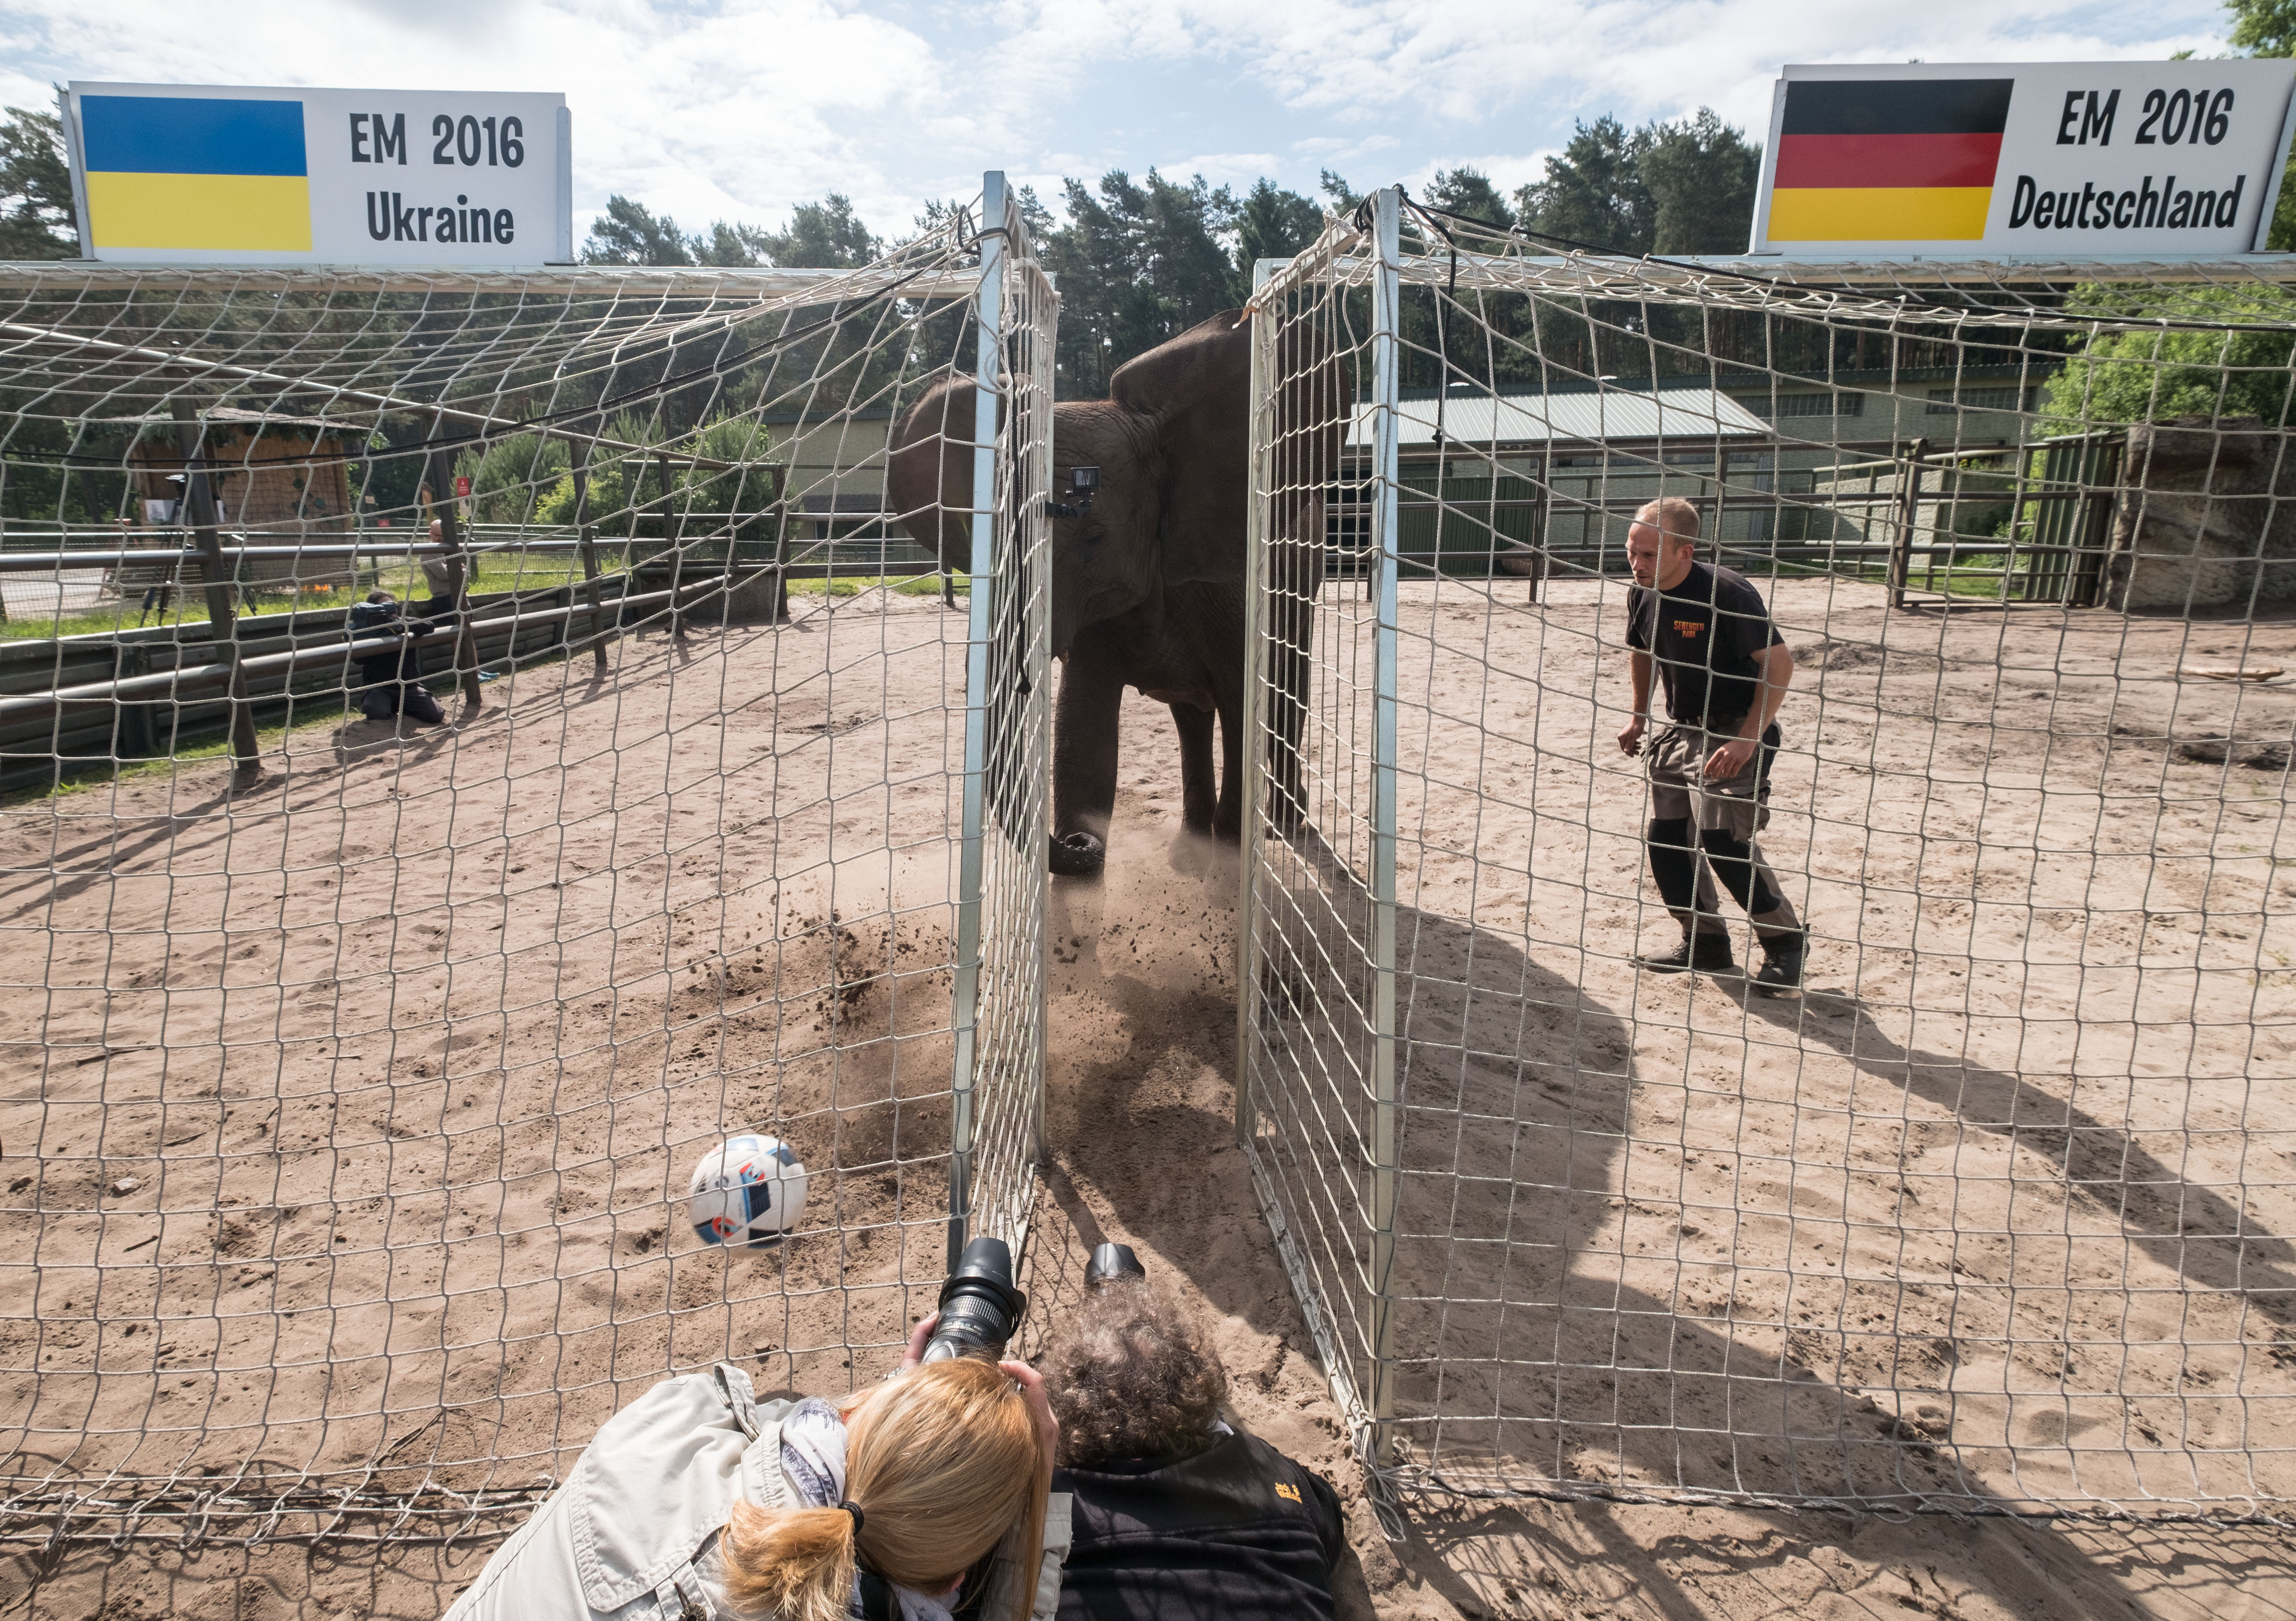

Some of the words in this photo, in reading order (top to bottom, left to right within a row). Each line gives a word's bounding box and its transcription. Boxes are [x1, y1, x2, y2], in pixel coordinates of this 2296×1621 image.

[350, 113, 407, 165] EM
[432, 114, 524, 168] 2016
[2056, 89, 2122, 146] EM
[2135, 88, 2235, 146] 2016
[367, 191, 514, 244] Ukraine
[2008, 175, 2246, 229] Deutschland
